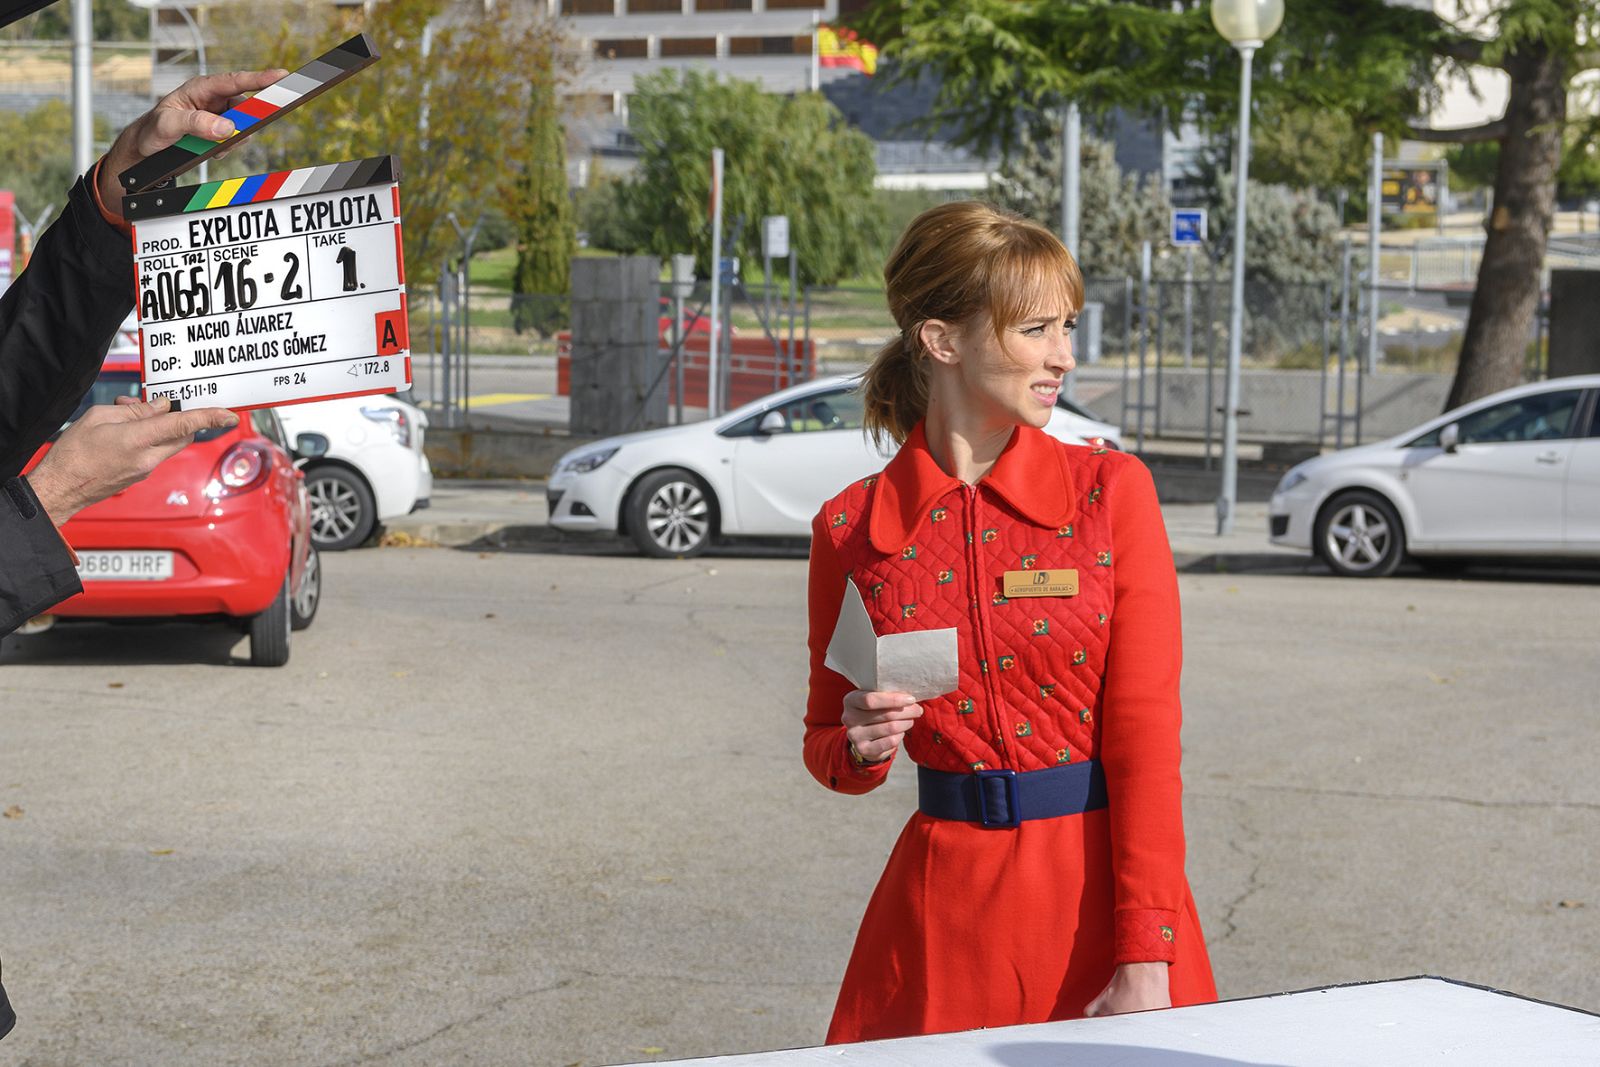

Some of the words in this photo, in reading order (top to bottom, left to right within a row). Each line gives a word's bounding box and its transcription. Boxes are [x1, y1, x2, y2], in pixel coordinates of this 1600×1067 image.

[142, 238, 182, 254] PROD.
[188, 208, 280, 248] EXPLOTA
[290, 193, 382, 233] EXPLOTA
[312, 232, 347, 248] TAKE
[213, 245, 259, 262] SCENE
[143, 257, 179, 272] ROLL
[150, 332, 176, 348] DIR:
[187, 320, 230, 343] NACHO
[236, 312, 294, 336] ÁLVAREZ
[382, 319, 398, 349] A
[151, 356, 182, 372] DoP:
[190, 347, 225, 368] JUAN
[228, 339, 279, 363] CARLOS
[283, 331, 327, 356] GÓMEZ
[273, 376, 291, 386] FPS
[293, 372, 307, 385] 24
[130, 555, 166, 573] HRF
